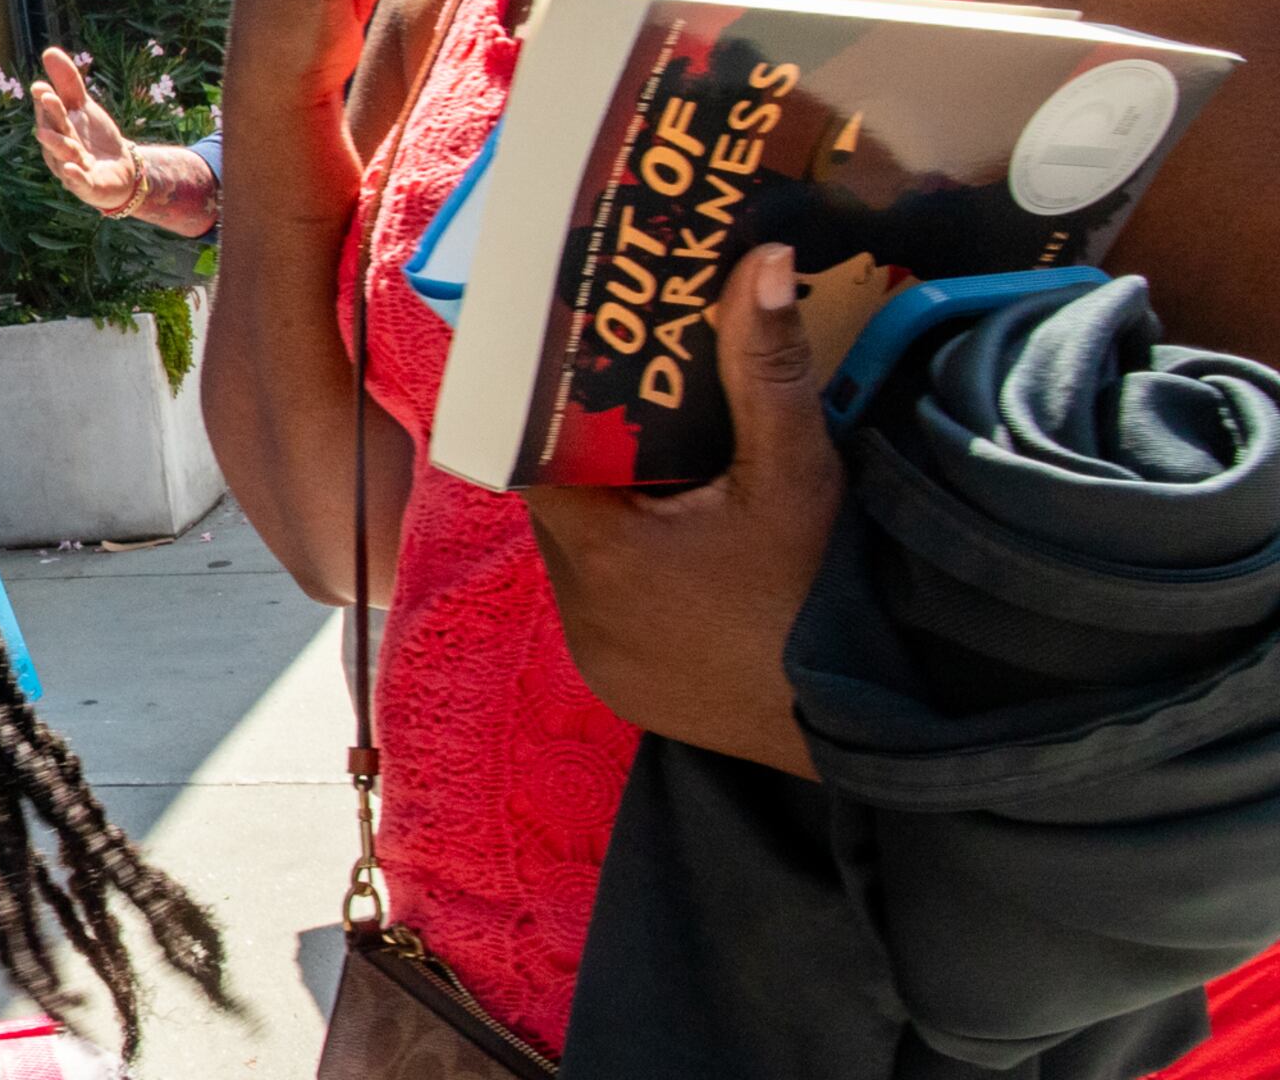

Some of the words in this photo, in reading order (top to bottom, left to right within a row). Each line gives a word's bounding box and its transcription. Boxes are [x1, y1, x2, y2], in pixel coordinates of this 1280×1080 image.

[595, 206, 667, 354] OUT
[642, 97, 706, 197] OF
[639, 62, 800, 409] DARKNESS
